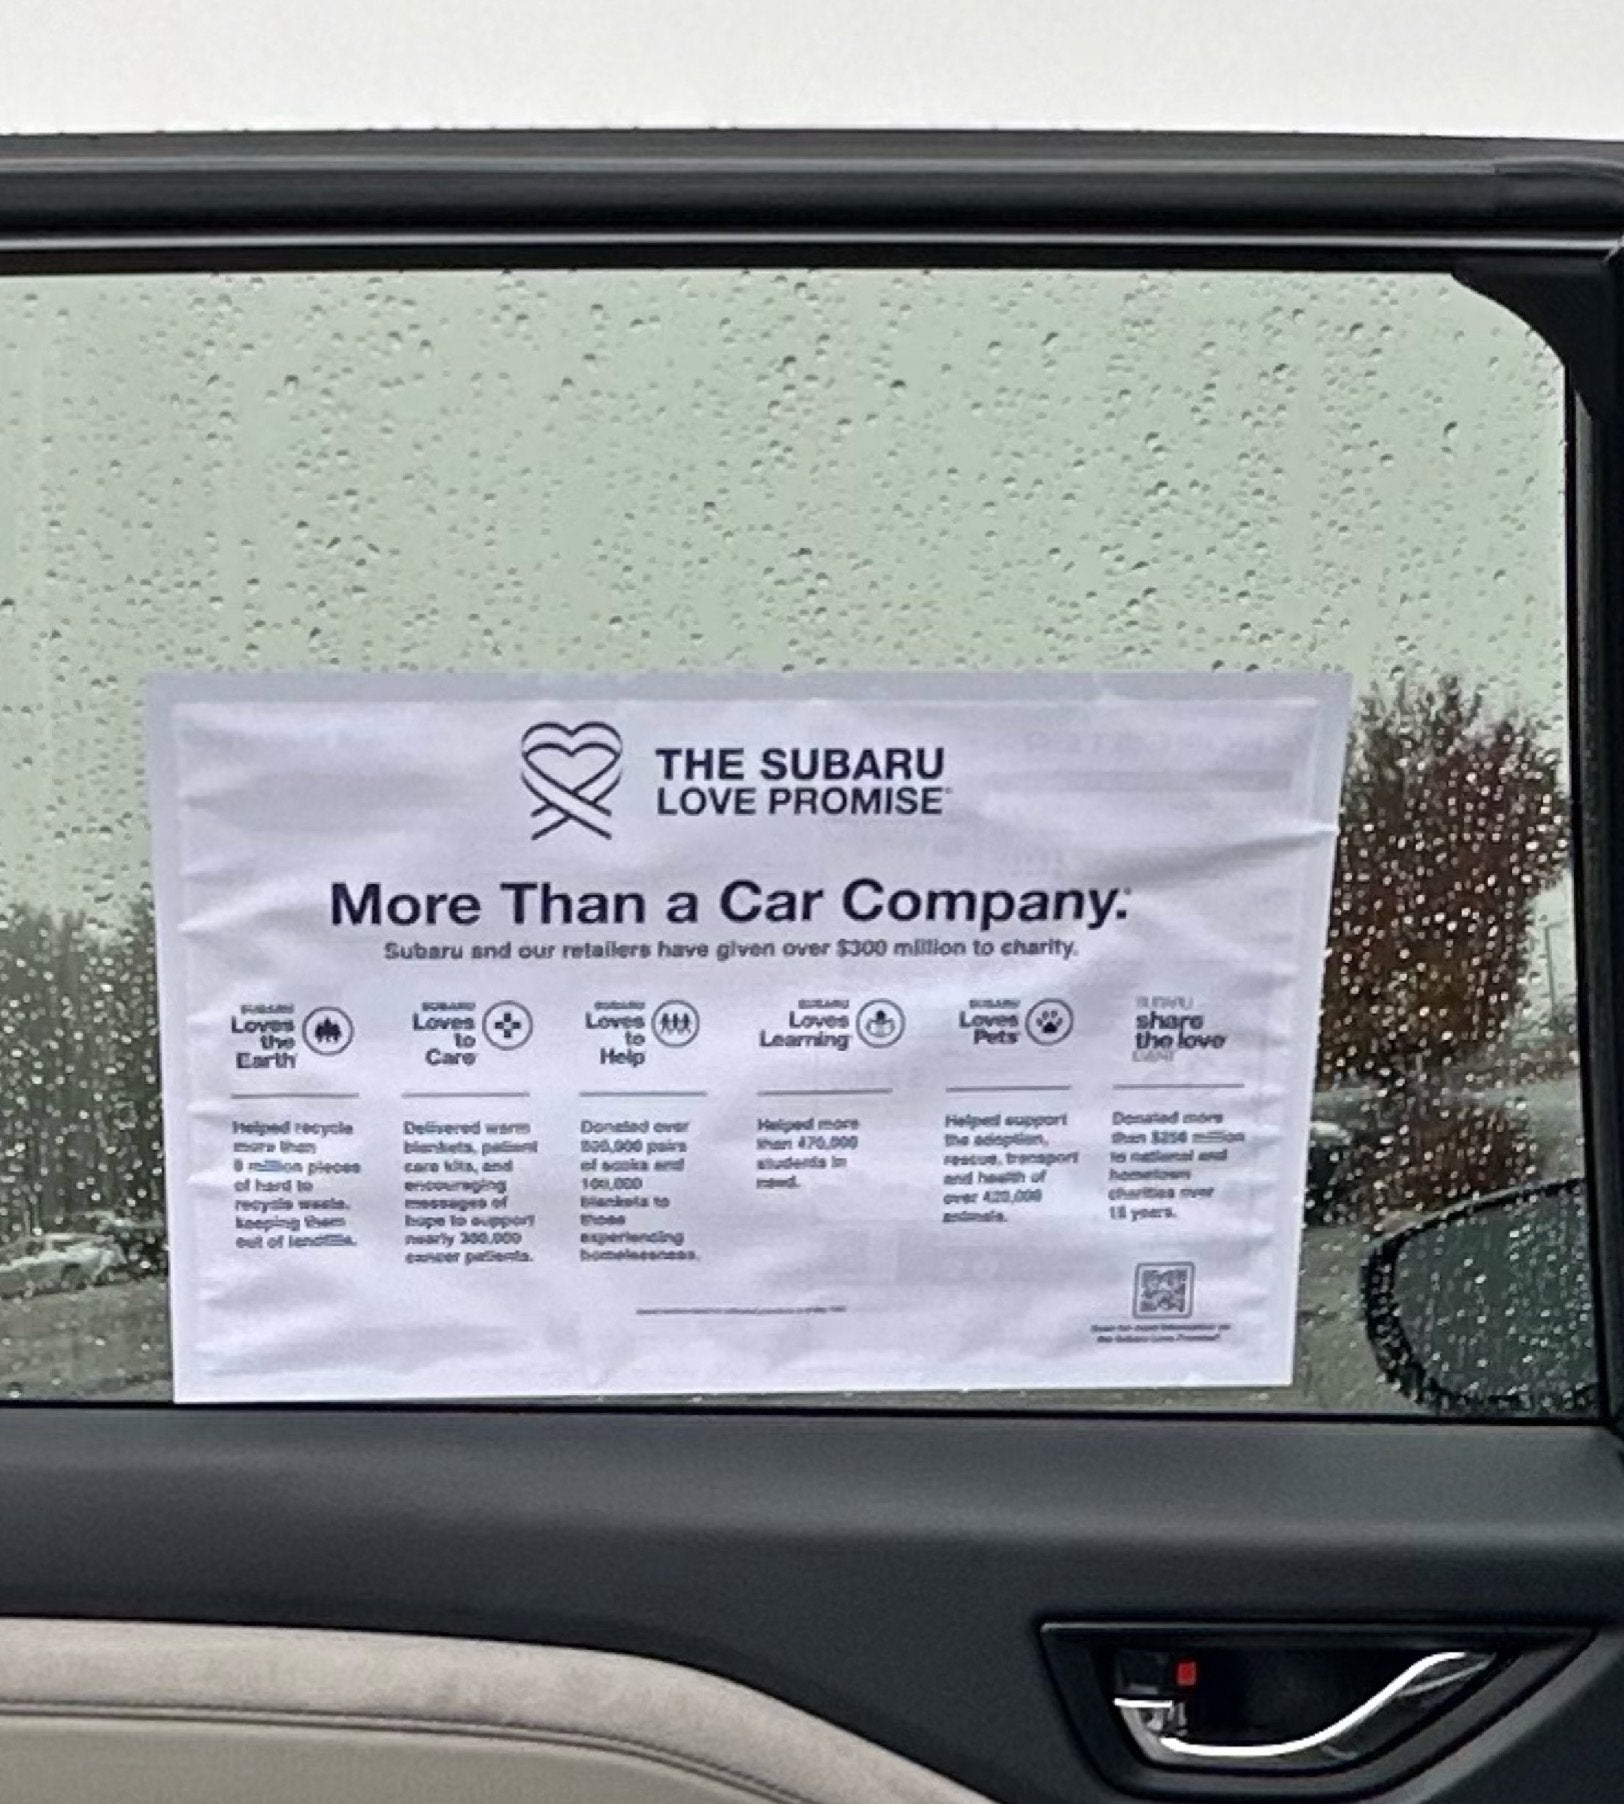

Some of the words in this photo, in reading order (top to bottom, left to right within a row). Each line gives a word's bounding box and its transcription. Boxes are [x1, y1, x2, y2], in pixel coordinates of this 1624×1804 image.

[656, 747, 745, 781] THE
[761, 746, 946, 781] SUBARU
[656, 786, 757, 816] LOVE
[331, 881, 481, 926] More
[499, 881, 646, 925] Than
[665, 890, 700, 925] a
[719, 878, 825, 923] Car
[383, 942, 463, 961] Subaru
[470, 941, 513, 960] and
[518, 944, 556, 960] our
[562, 940, 651, 960] retailers
[657, 940, 709, 959] have
[716, 939, 776, 962] given
[782, 941, 832, 958] over
[836, 938, 888, 958] $300
[893, 938, 967, 957] million
[972, 938, 996, 957] to
[1000, 937, 1079, 961] charity.
[231, 1014, 297, 1034] Loves
[411, 1011, 477, 1033] Loves
[584, 1011, 646, 1031] Loves
[788, 1010, 850, 1030] Loves
[958, 1010, 1021, 1029] Loves
[1135, 1010, 1205, 1030] share
[260, 1033, 297, 1050] the
[454, 1031, 477, 1050] to
[624, 1029, 646, 1047] to
[759, 1028, 850, 1051] Learning
[973, 1028, 1020, 1046] Pets
[1134, 1030, 1174, 1050] the
[1177, 1029, 1227, 1050] love
[235, 1050, 297, 1070] Earth
[424, 1047, 477, 1067] Care
[599, 1046, 646, 1068] Help
